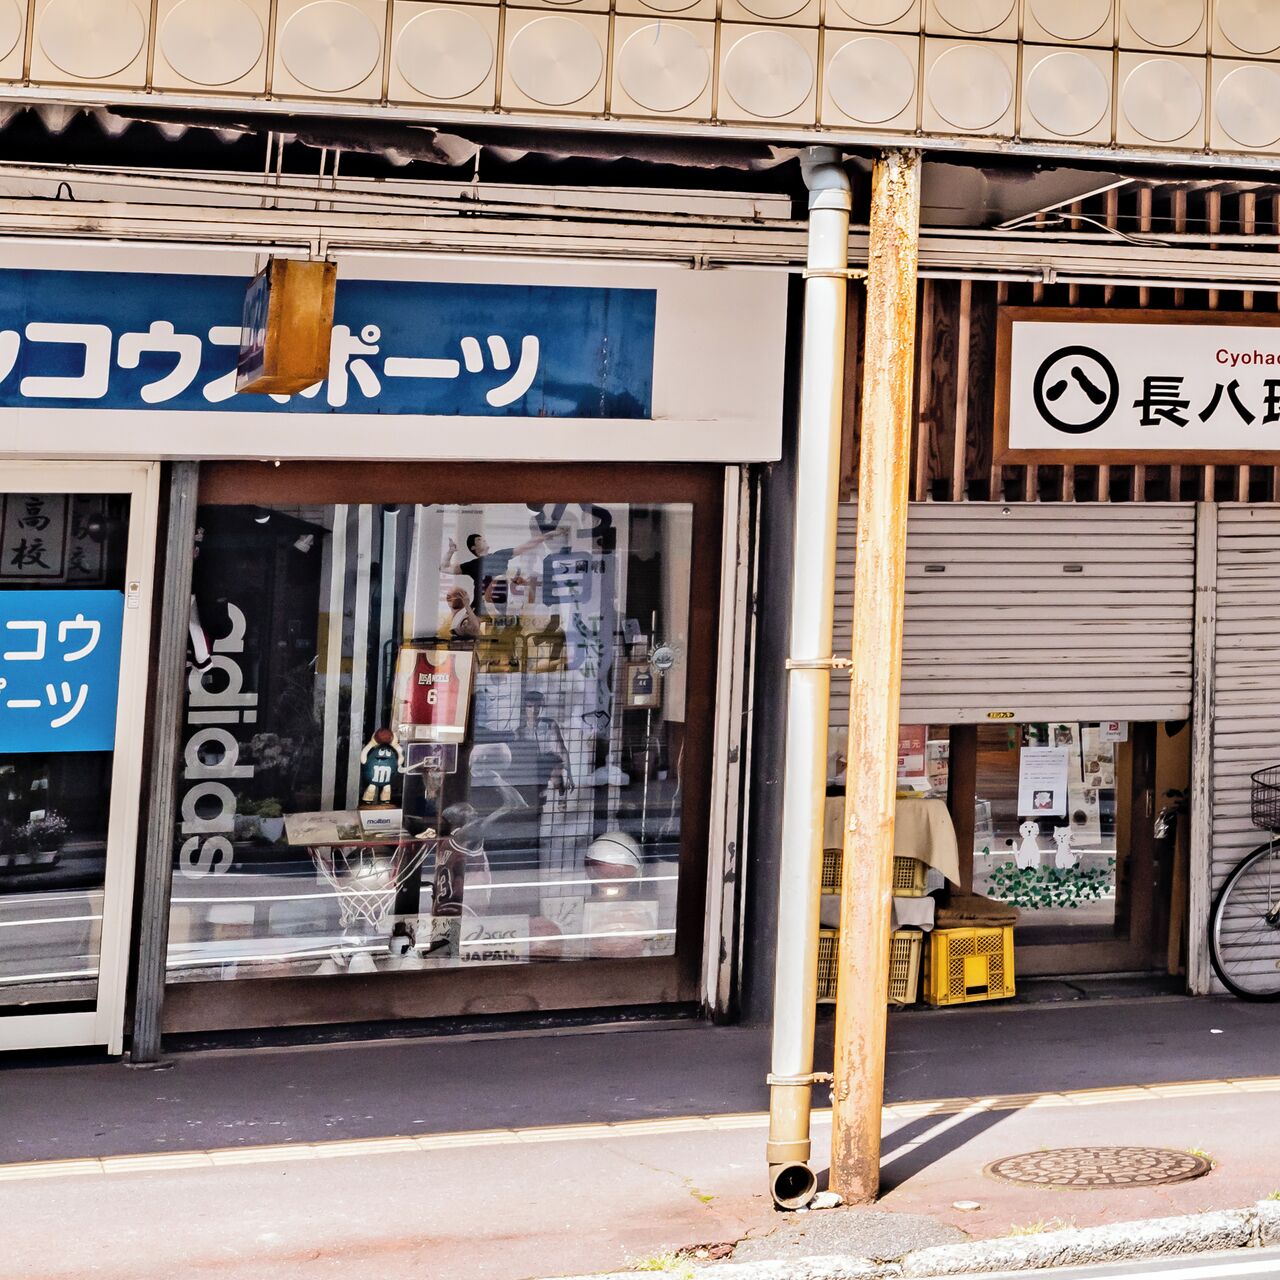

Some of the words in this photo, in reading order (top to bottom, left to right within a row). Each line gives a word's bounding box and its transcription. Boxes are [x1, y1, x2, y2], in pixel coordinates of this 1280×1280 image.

[0, 320, 540, 408] コウポーツ
[0, 676, 89, 728] ーツ
[426, 688, 438, 705] 6
